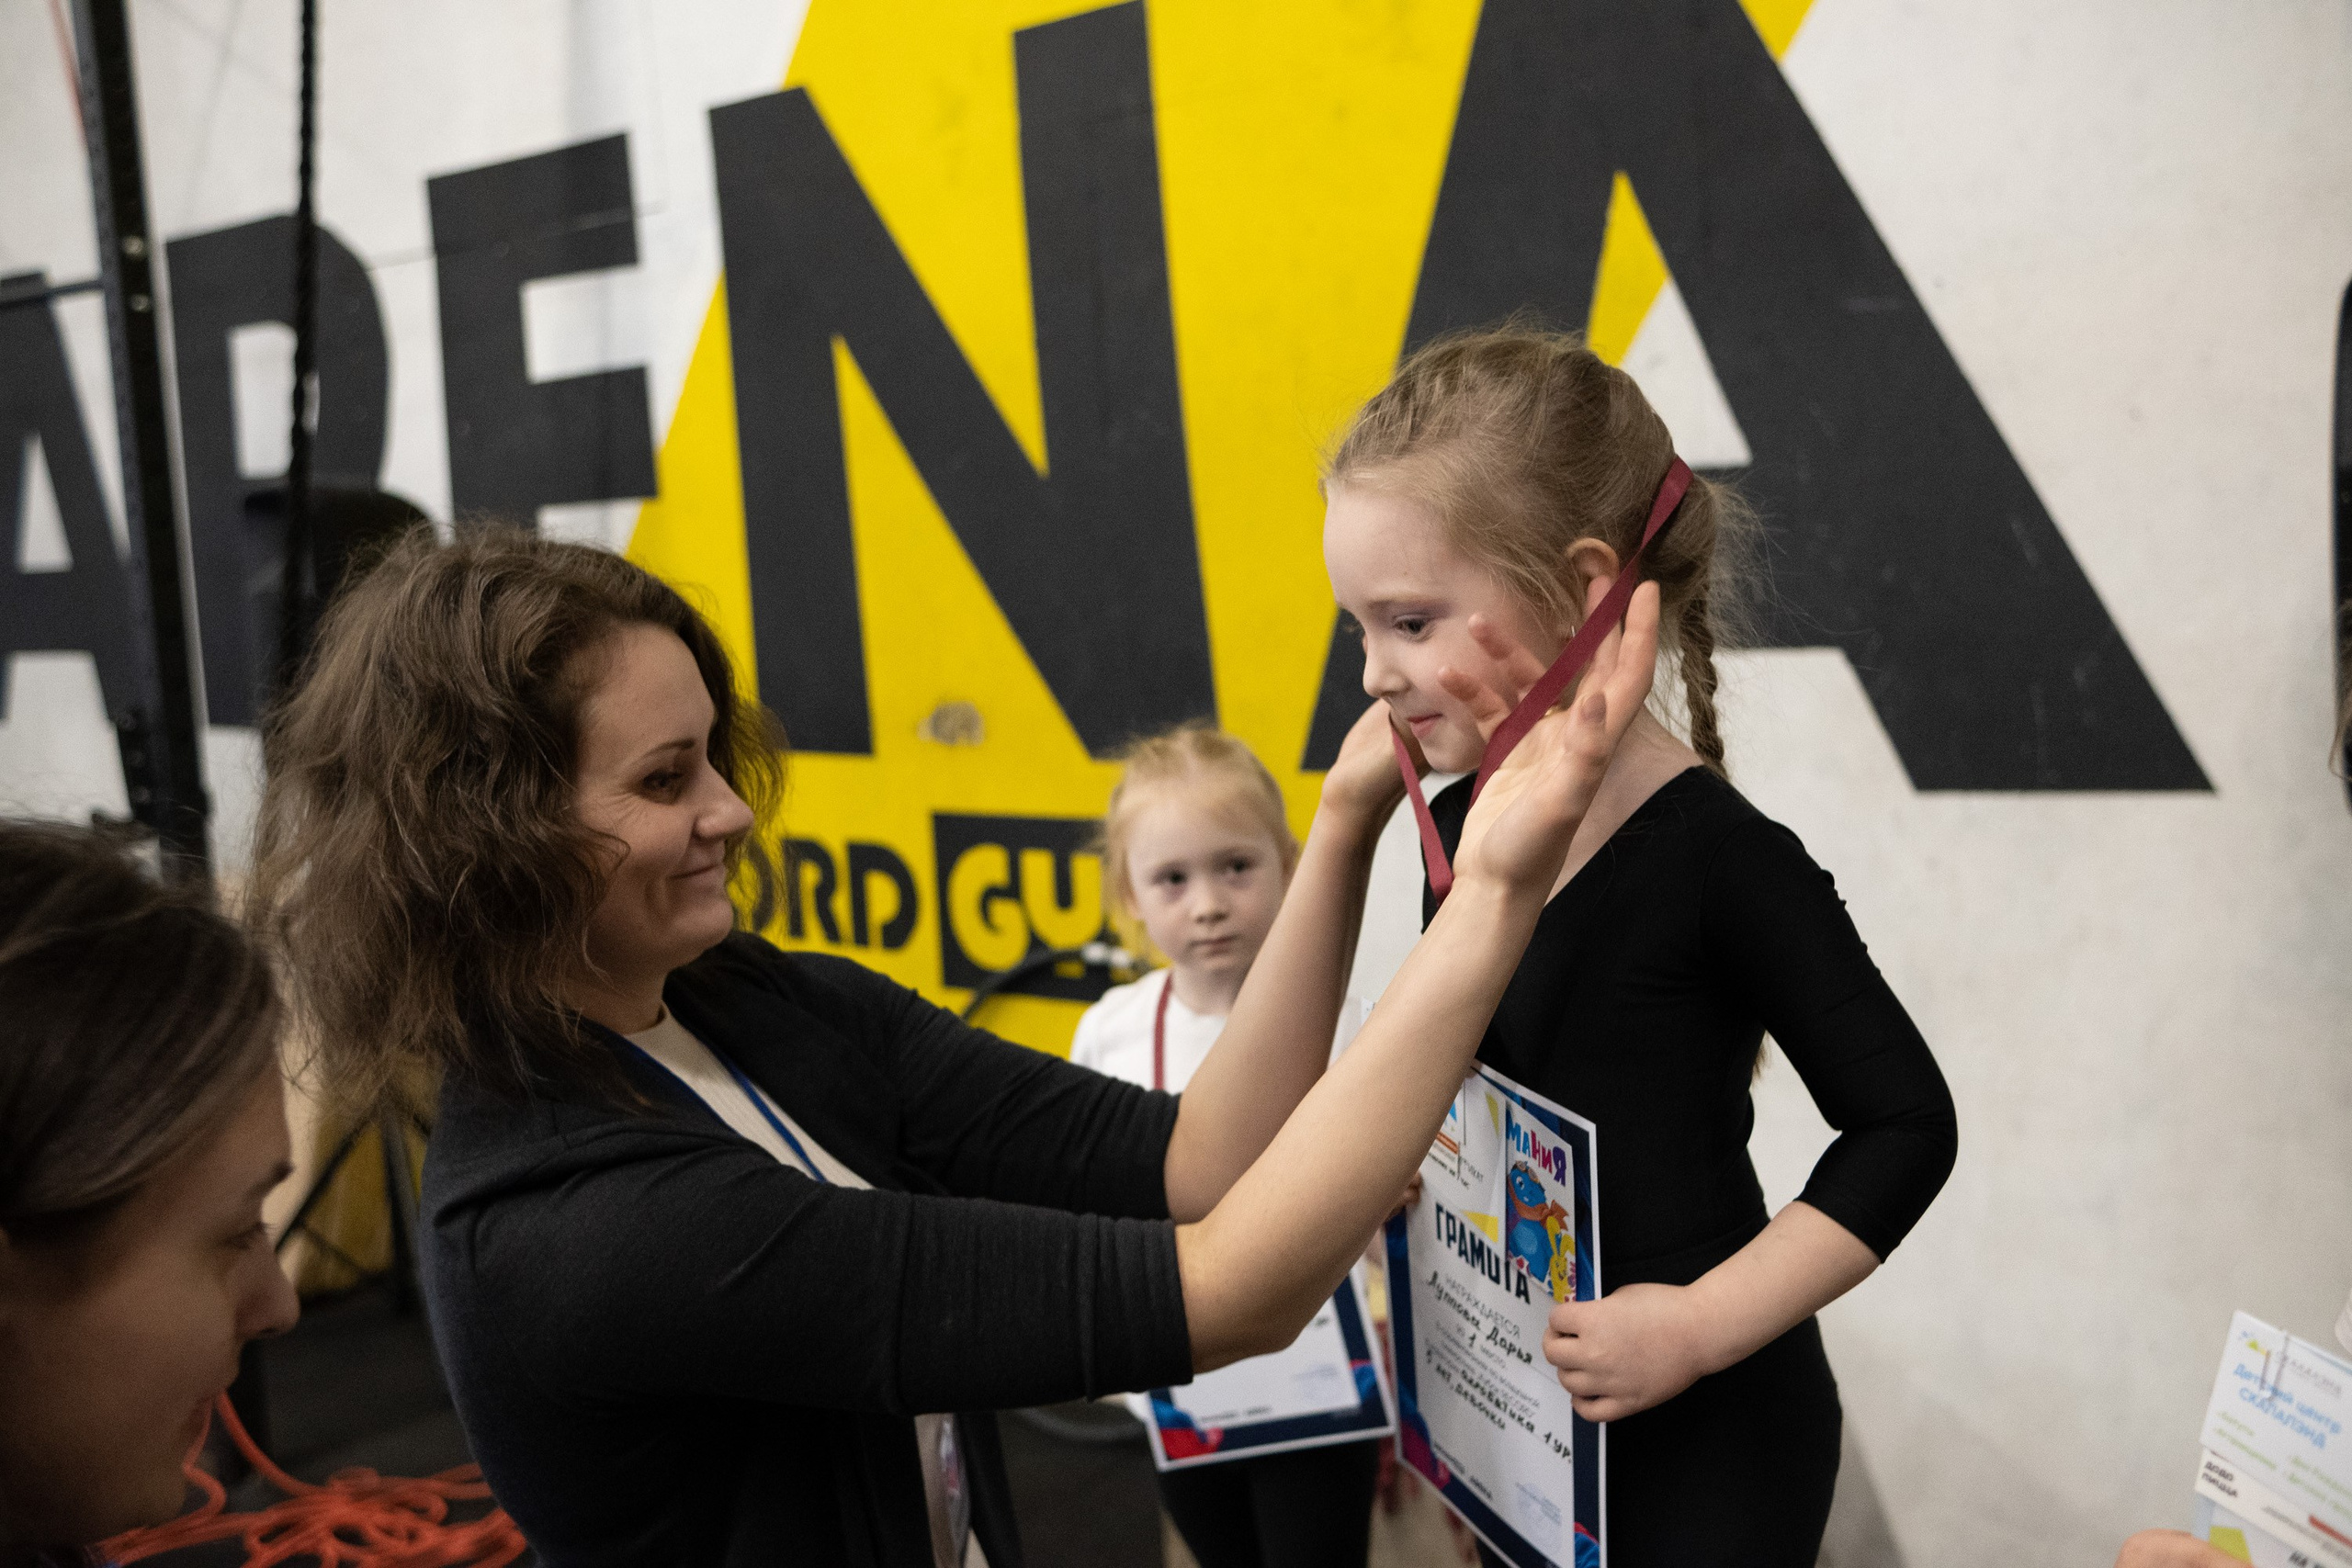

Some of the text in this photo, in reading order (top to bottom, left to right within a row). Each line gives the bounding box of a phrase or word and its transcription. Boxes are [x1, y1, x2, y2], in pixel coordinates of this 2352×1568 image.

[0, 0, 2217, 794] ARENA
[731, 836, 1104, 971] ORD GU
[1487, 1327, 1532, 1364] Дарья
